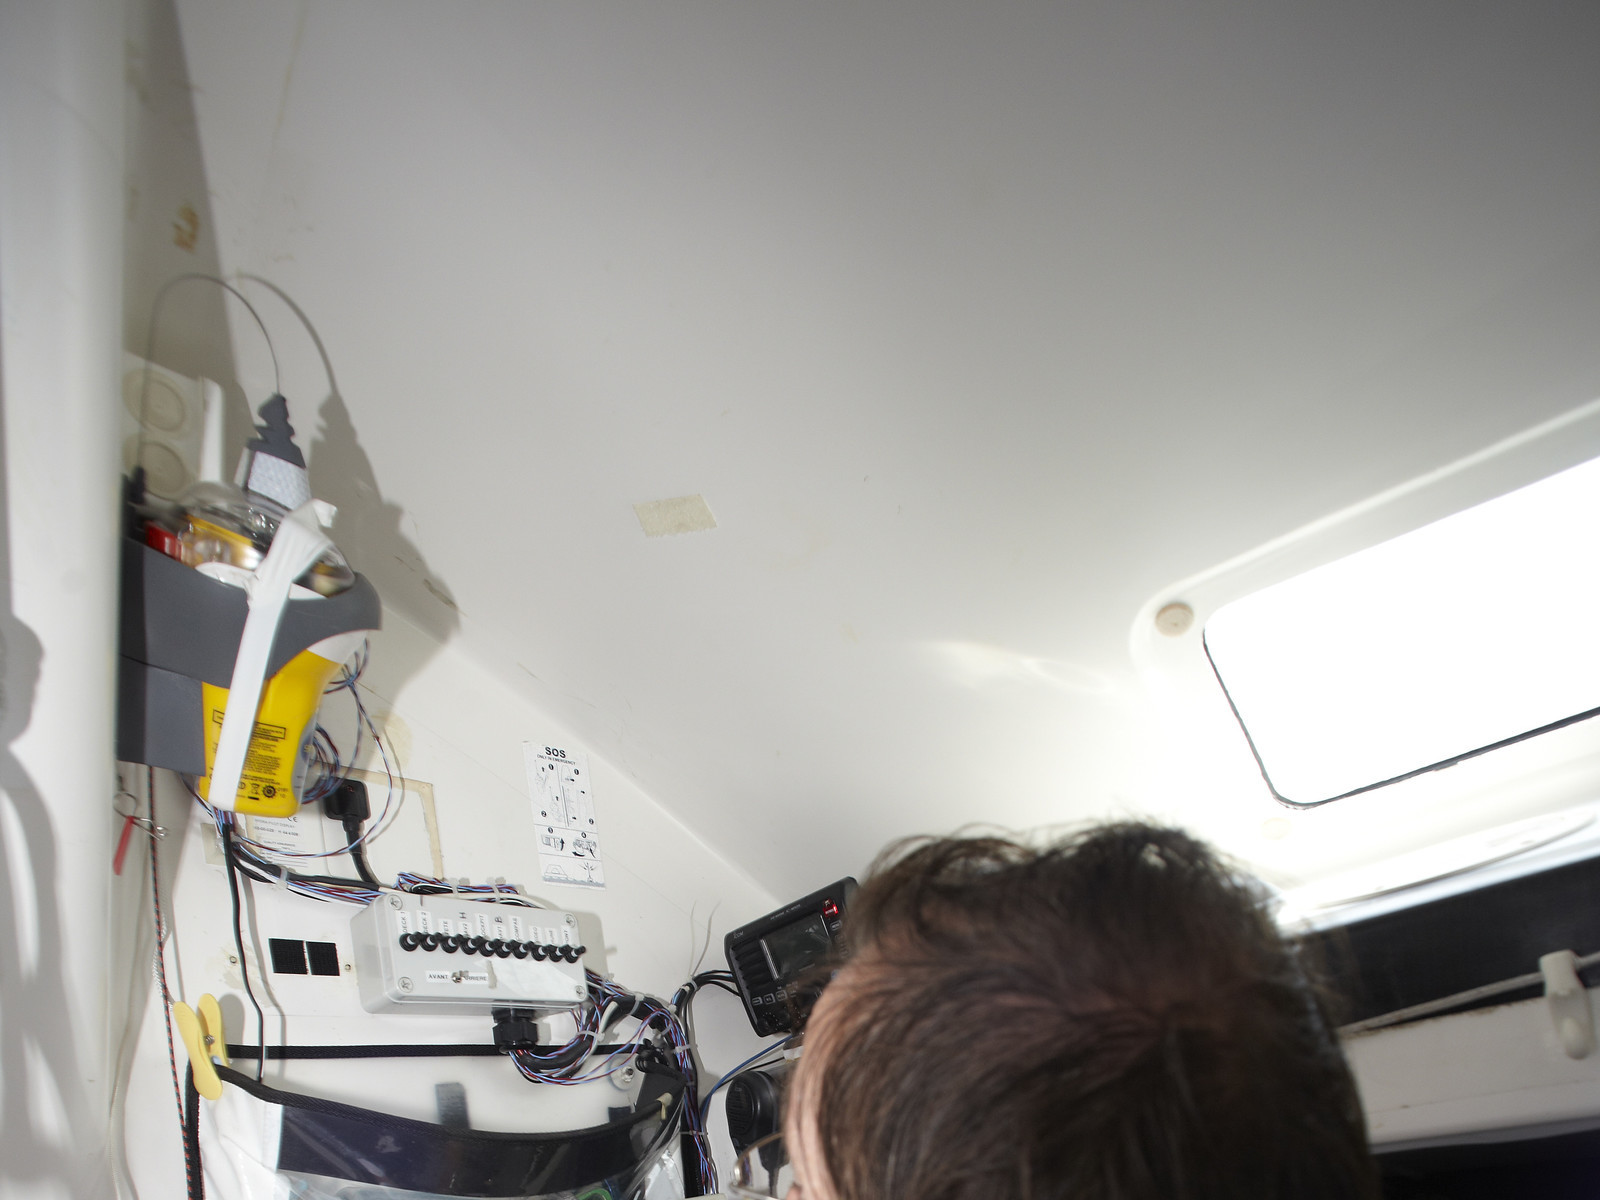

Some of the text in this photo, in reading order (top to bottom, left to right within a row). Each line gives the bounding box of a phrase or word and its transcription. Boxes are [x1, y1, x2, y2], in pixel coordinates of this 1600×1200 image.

[545, 746, 566, 759] SOS
[553, 757, 576, 765] EMERGENCY
[400, 916, 408, 933] DECK
